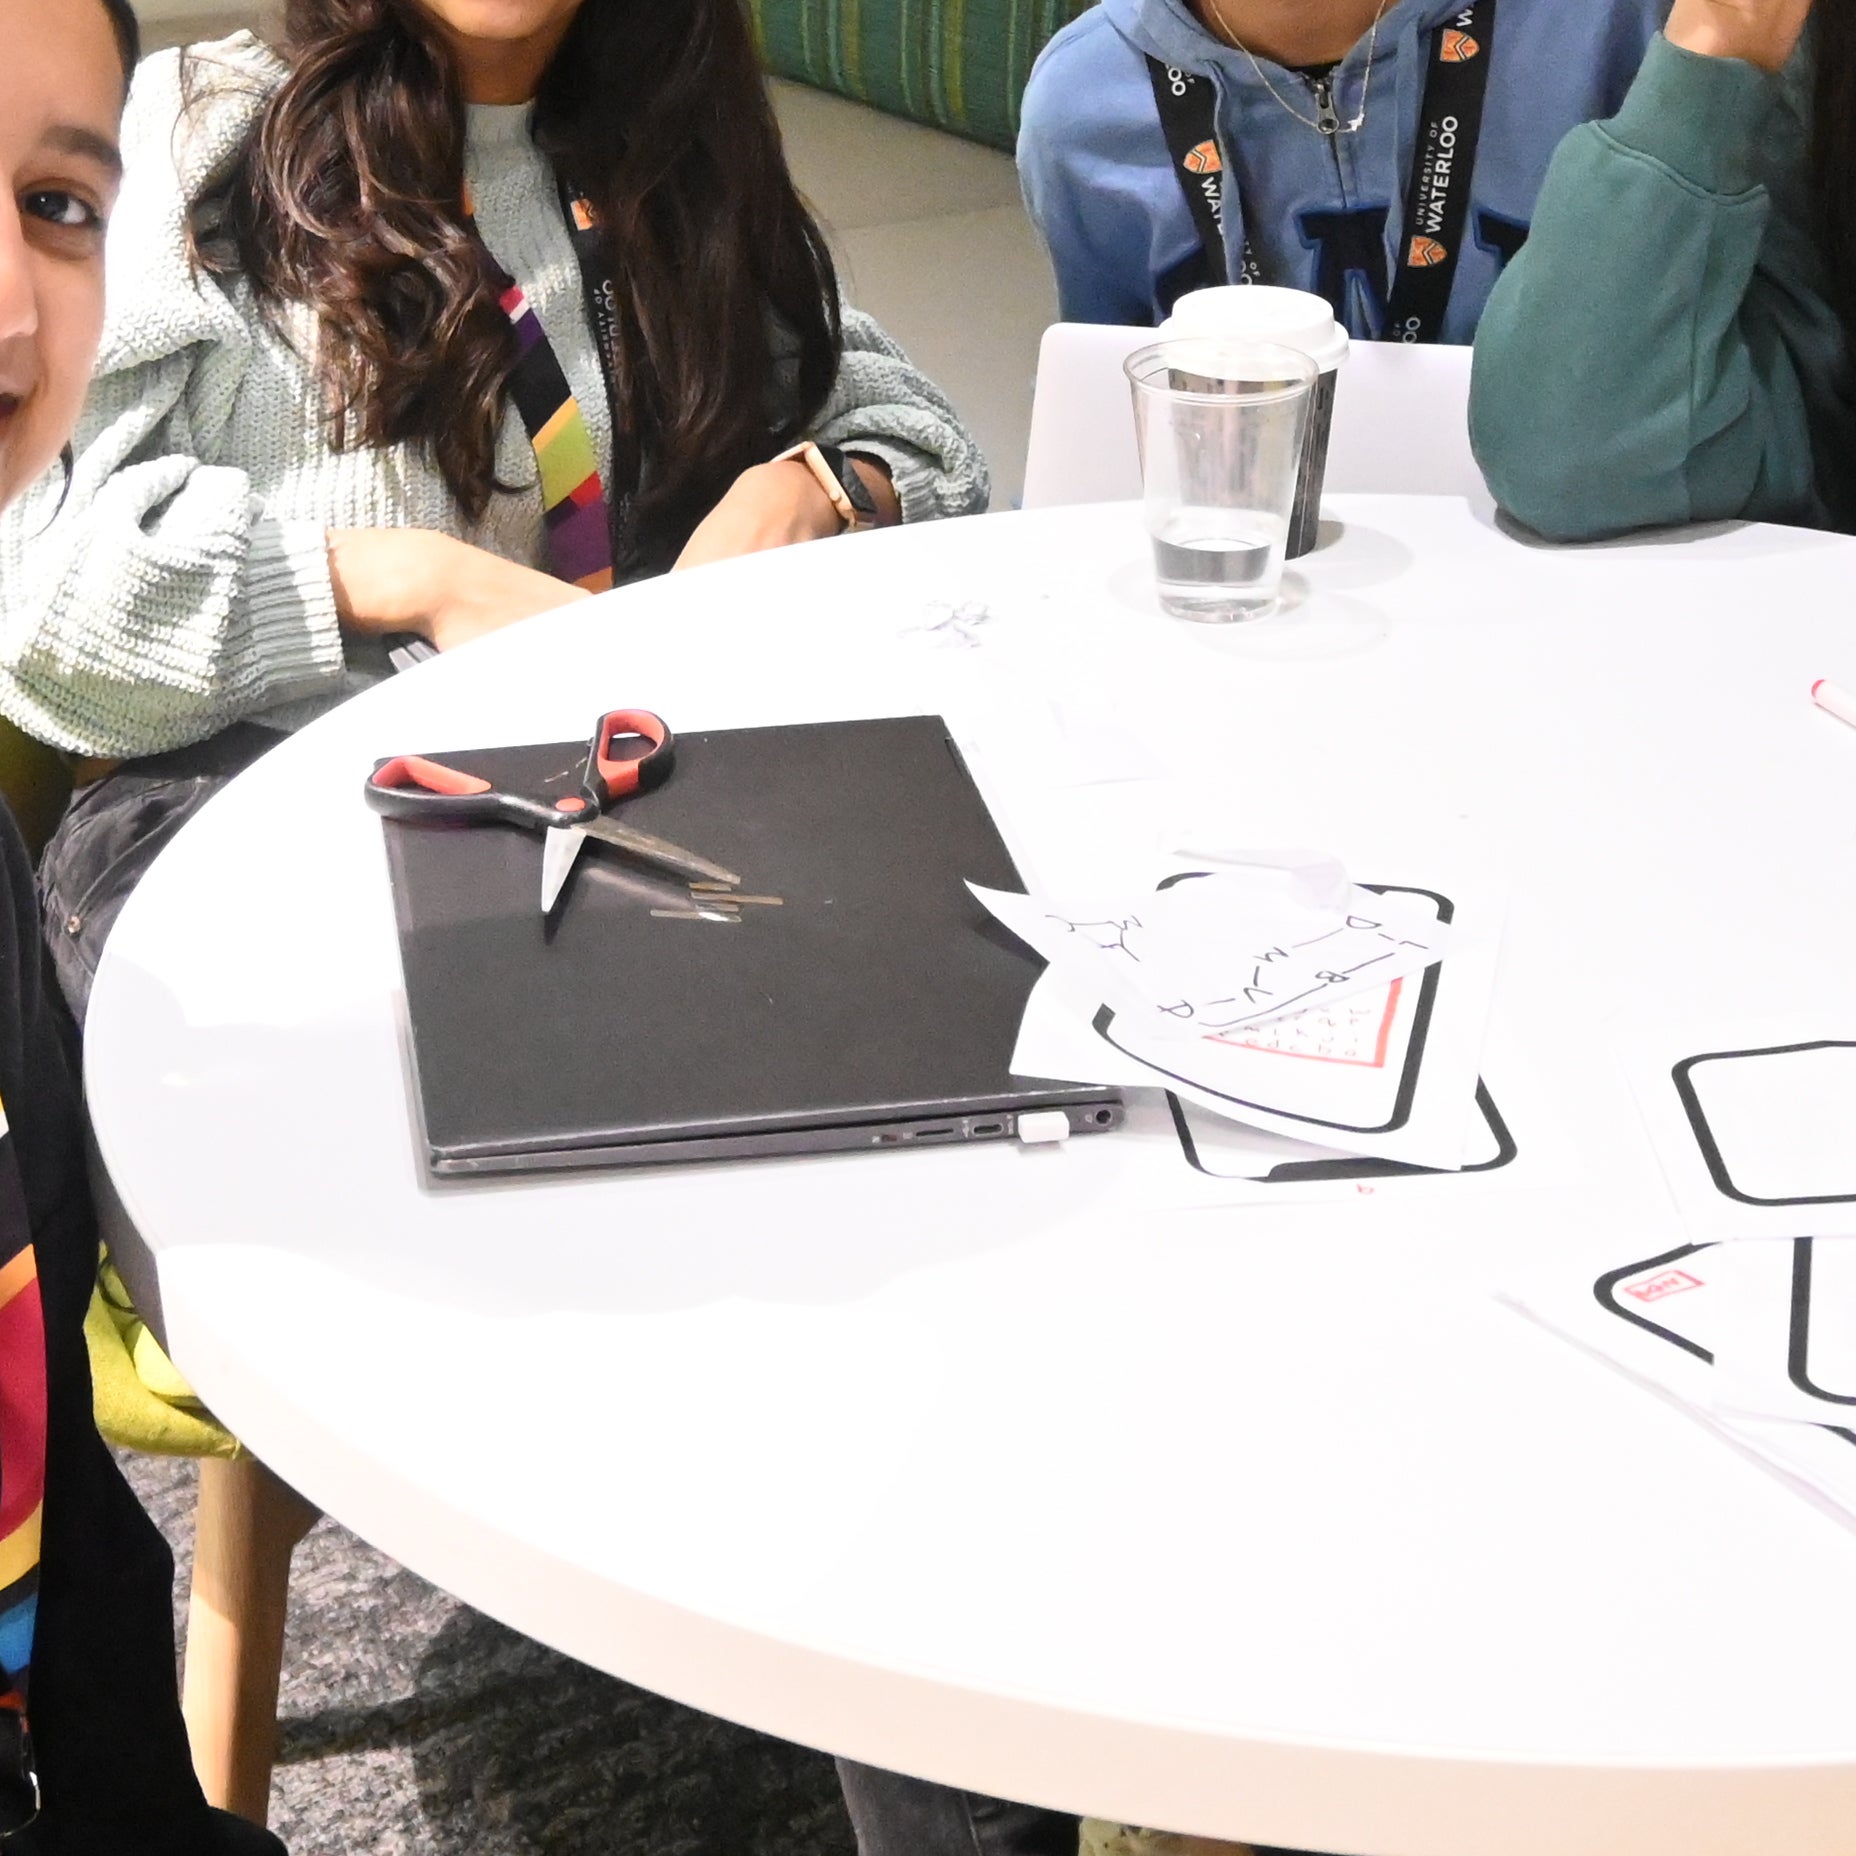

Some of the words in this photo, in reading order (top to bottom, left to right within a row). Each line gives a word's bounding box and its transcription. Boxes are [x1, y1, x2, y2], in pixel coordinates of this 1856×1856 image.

[1416, 145, 1436, 226] UNIVERSITY
[1429, 121, 1439, 138] OF
[1425, 116, 1459, 233] WATERLOO
